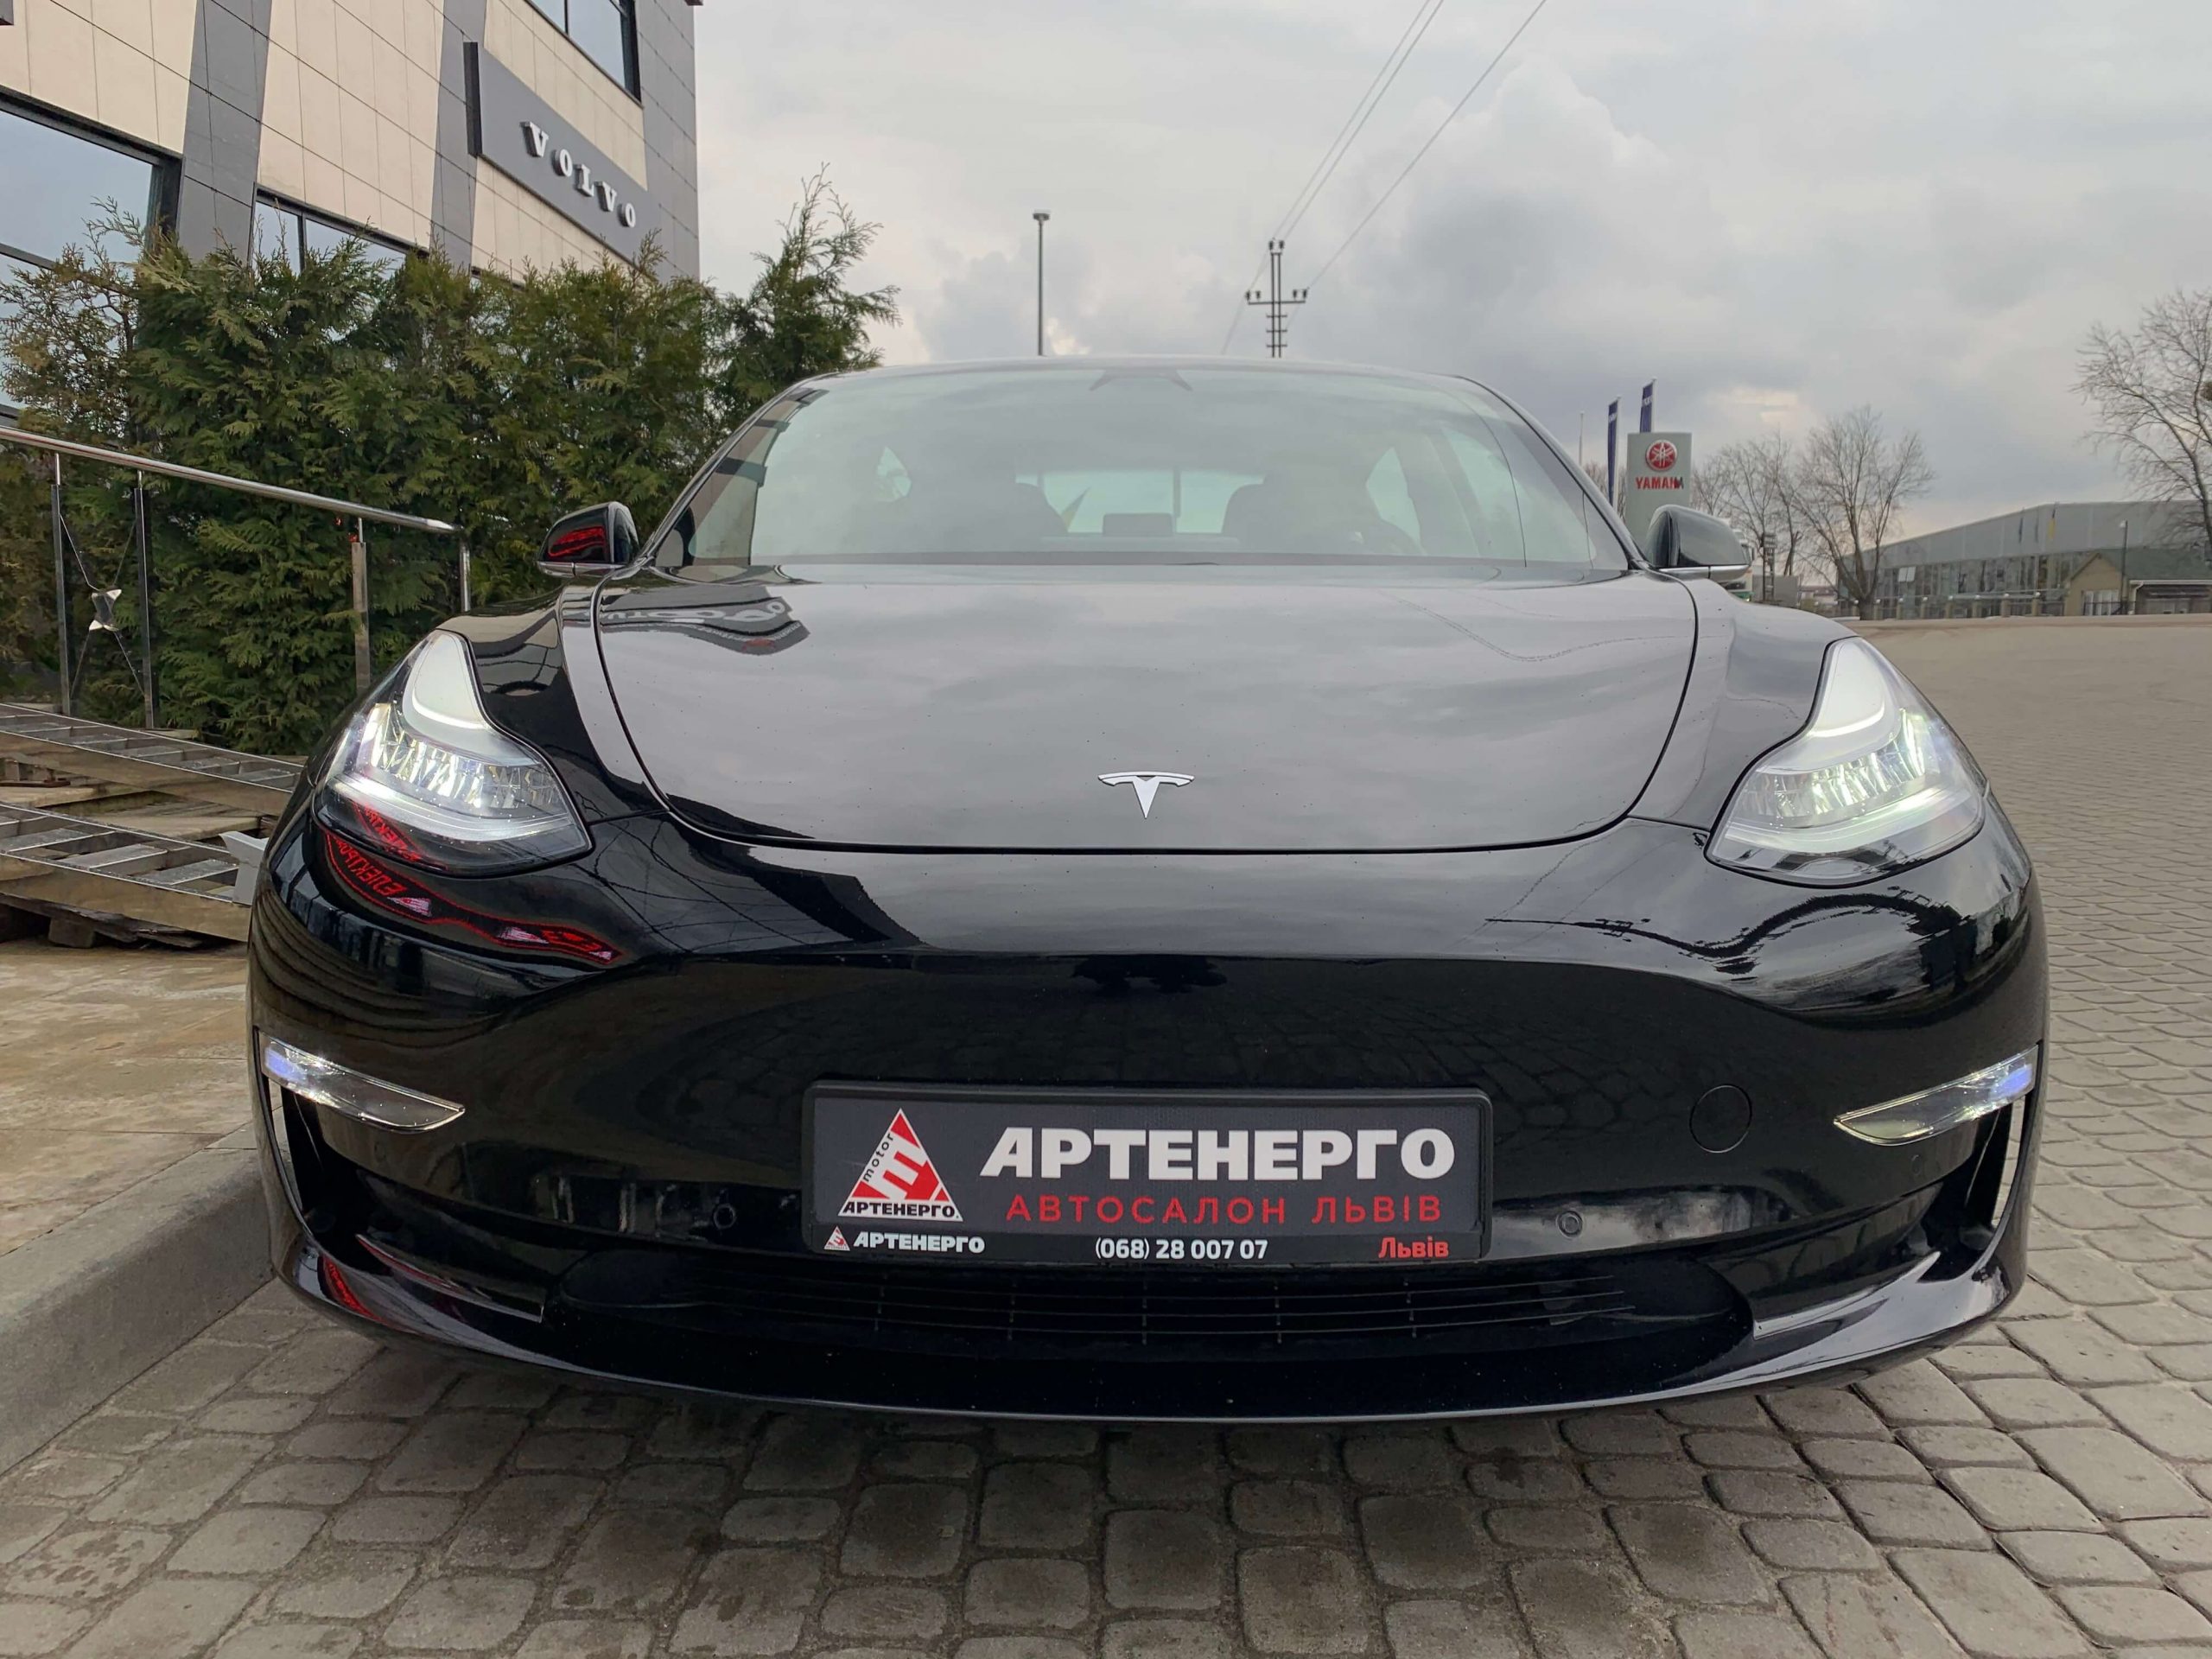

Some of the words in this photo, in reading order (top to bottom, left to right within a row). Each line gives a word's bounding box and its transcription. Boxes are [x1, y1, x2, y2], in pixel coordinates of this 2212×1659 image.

[520, 121, 637, 228] VOLVO
[862, 1132, 894, 1183] motor
[980, 1127, 1455, 1181] АРТЕНЕРГО
[842, 1201, 956, 1218] АРТЕНЕРГО
[1006, 1194, 1285, 1224] АВТОСАЛОН
[1312, 1194, 1441, 1224] ЛЬВІВ
[853, 1230, 985, 1254] АРТЕНЕРГО
[1095, 1237, 1150, 1260] (068)
[1155, 1239, 1185, 1259] 28
[1378, 1236, 1449, 1258] Львів
